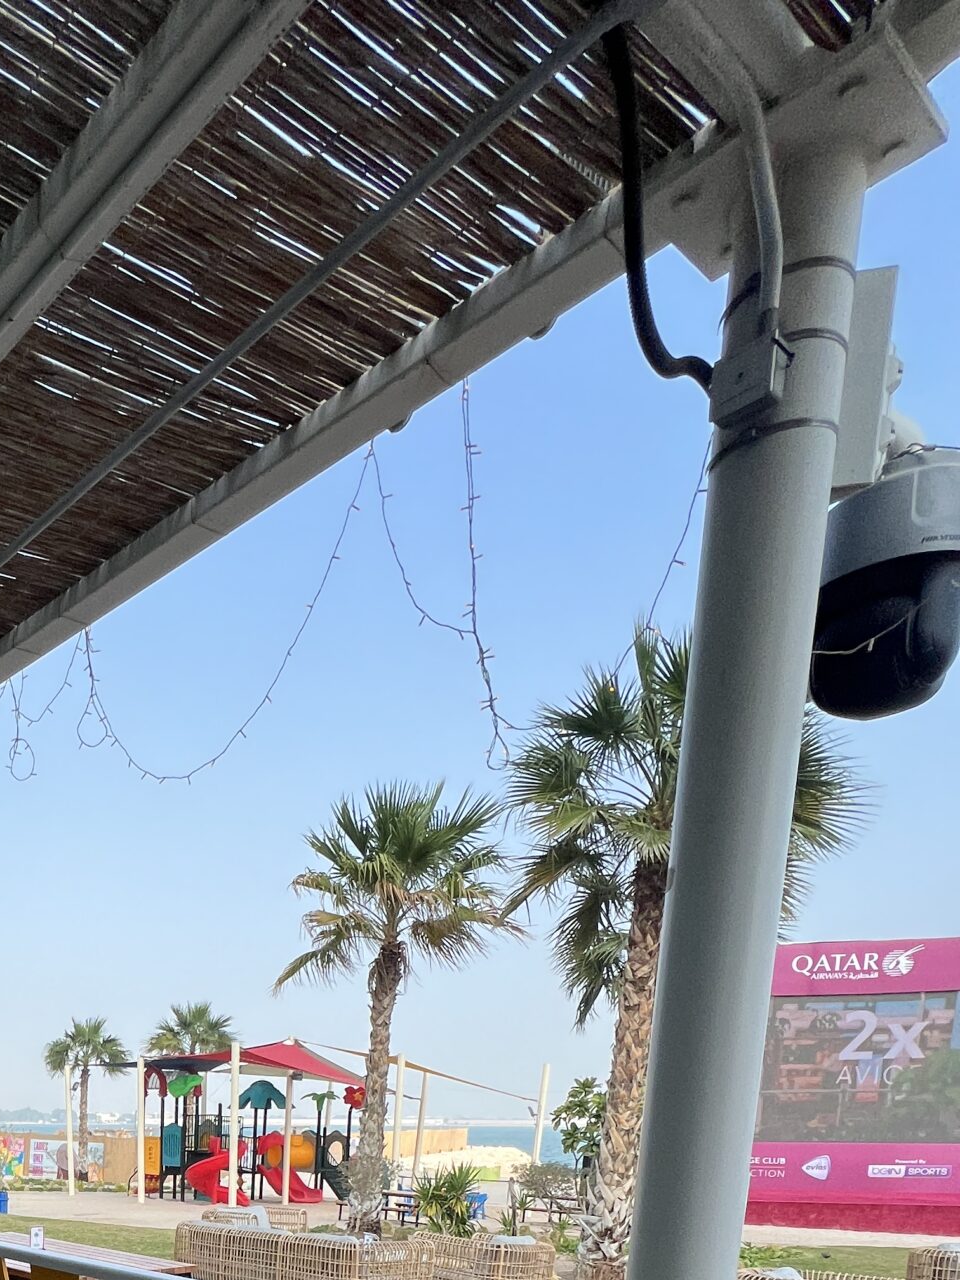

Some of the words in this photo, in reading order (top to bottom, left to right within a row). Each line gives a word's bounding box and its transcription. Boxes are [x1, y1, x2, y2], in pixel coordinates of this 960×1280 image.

[791, 952, 879, 977] QATAR
[810, 972, 848, 980] AIRWAYS
[762, 1157, 786, 1165] CLUB
[750, 1169, 786, 1178] CTION
[908, 1167, 948, 1176] SPORTS
